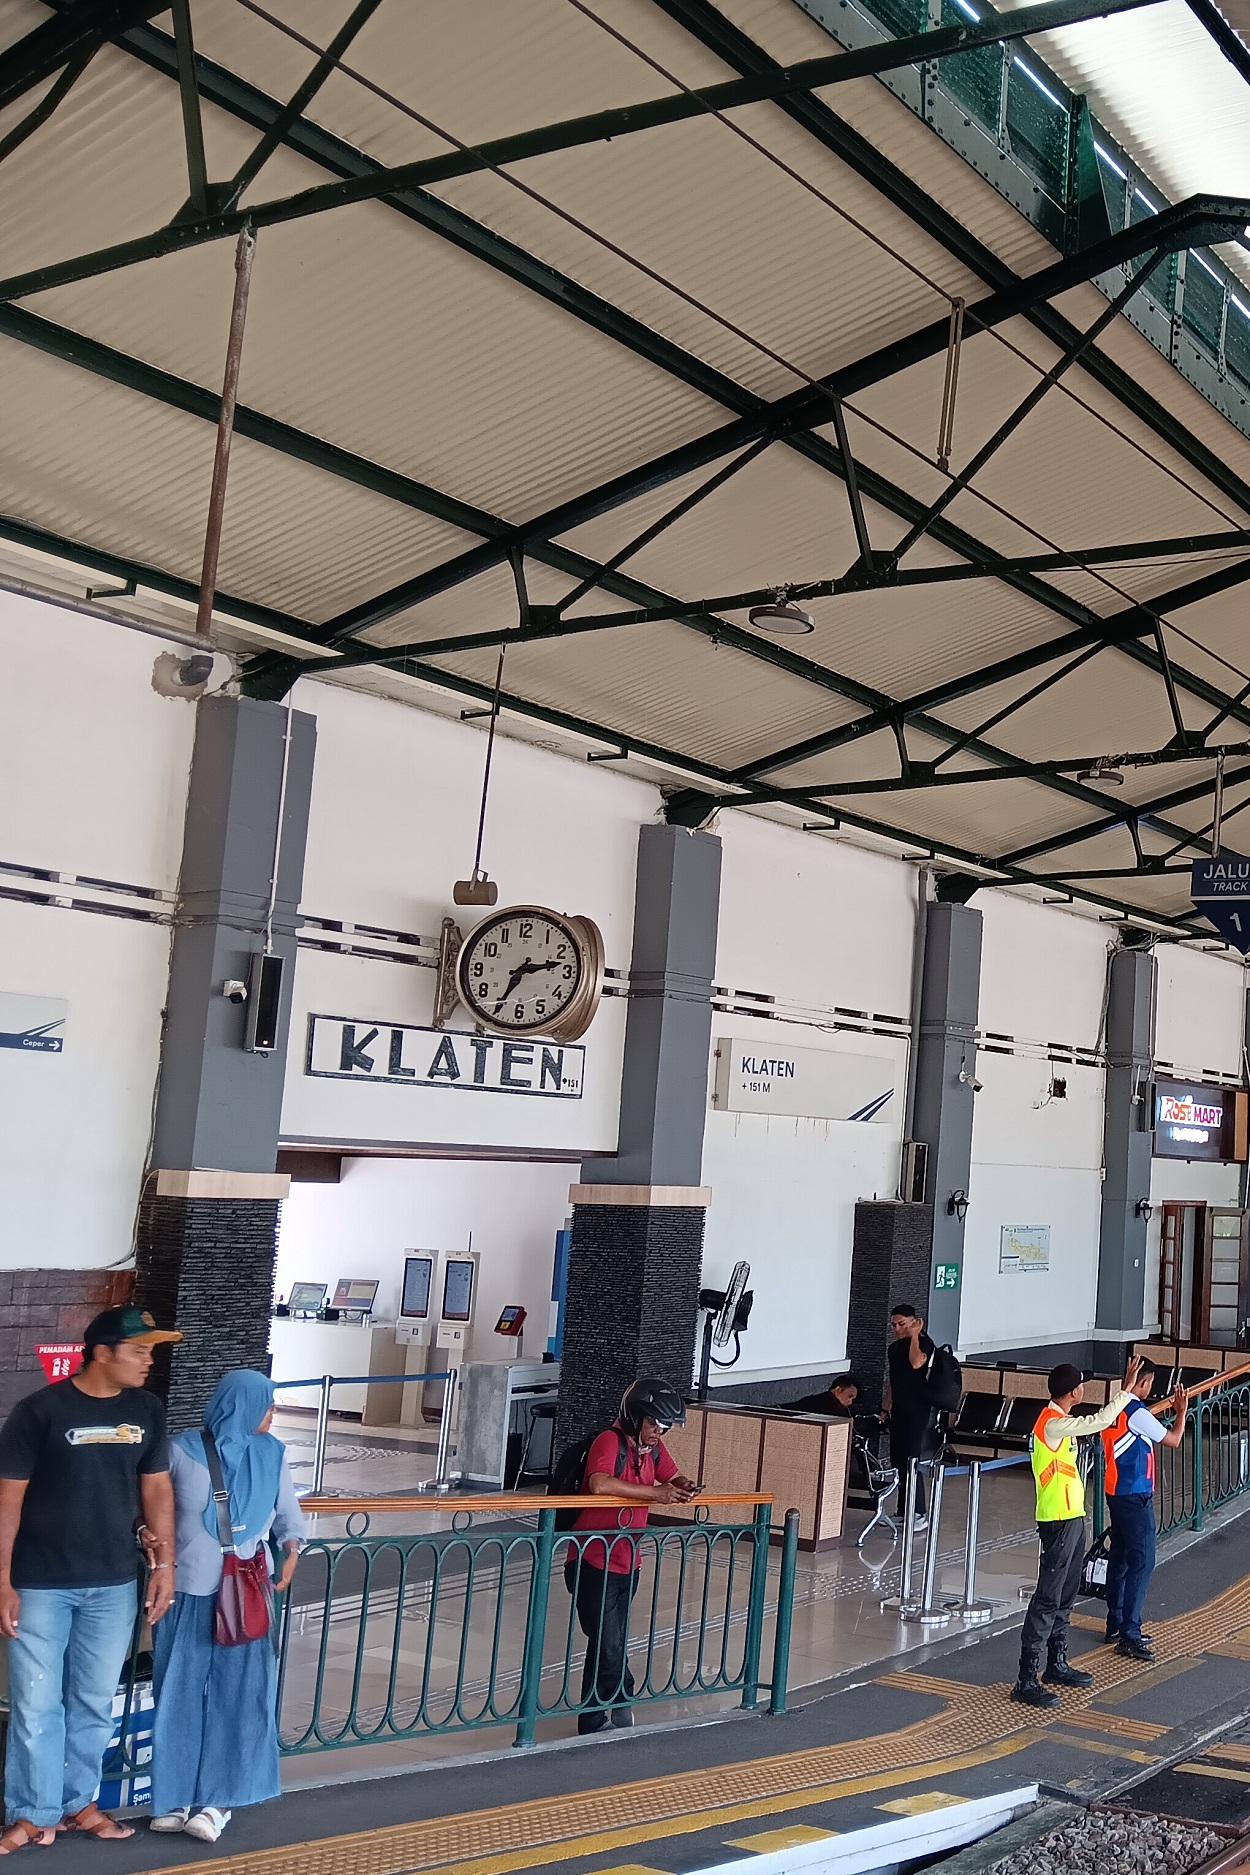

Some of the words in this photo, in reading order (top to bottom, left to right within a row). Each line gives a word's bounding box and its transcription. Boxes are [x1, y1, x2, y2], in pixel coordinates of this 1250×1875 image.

[1212, 881, 1249, 892] TRACK
[1229, 912, 1242, 932] 1
[501, 928, 510, 944] 11
[519, 922, 534, 939] 12
[545, 929, 551, 945] 1
[483, 942, 498, 958] 10
[556, 944, 567, 960] 2
[473, 962, 484, 978] 9
[562, 964, 573, 980] 3
[478, 982, 489, 998] 8
[551, 984, 563, 1001] 4
[514, 1003, 525, 1020] 6
[535, 999, 546, 1015] 5
[22, 1038, 45, 1048] Ceper
[339, 1024, 564, 1091] KLATEN
[741, 1056, 795, 1078] KLATEN
[749, 1081, 761, 1092] 151
[762, 1082, 771, 1093] M
[1193, 1106, 1222, 1125] MART
[38, 1345, 74, 1354] PEMADAM
